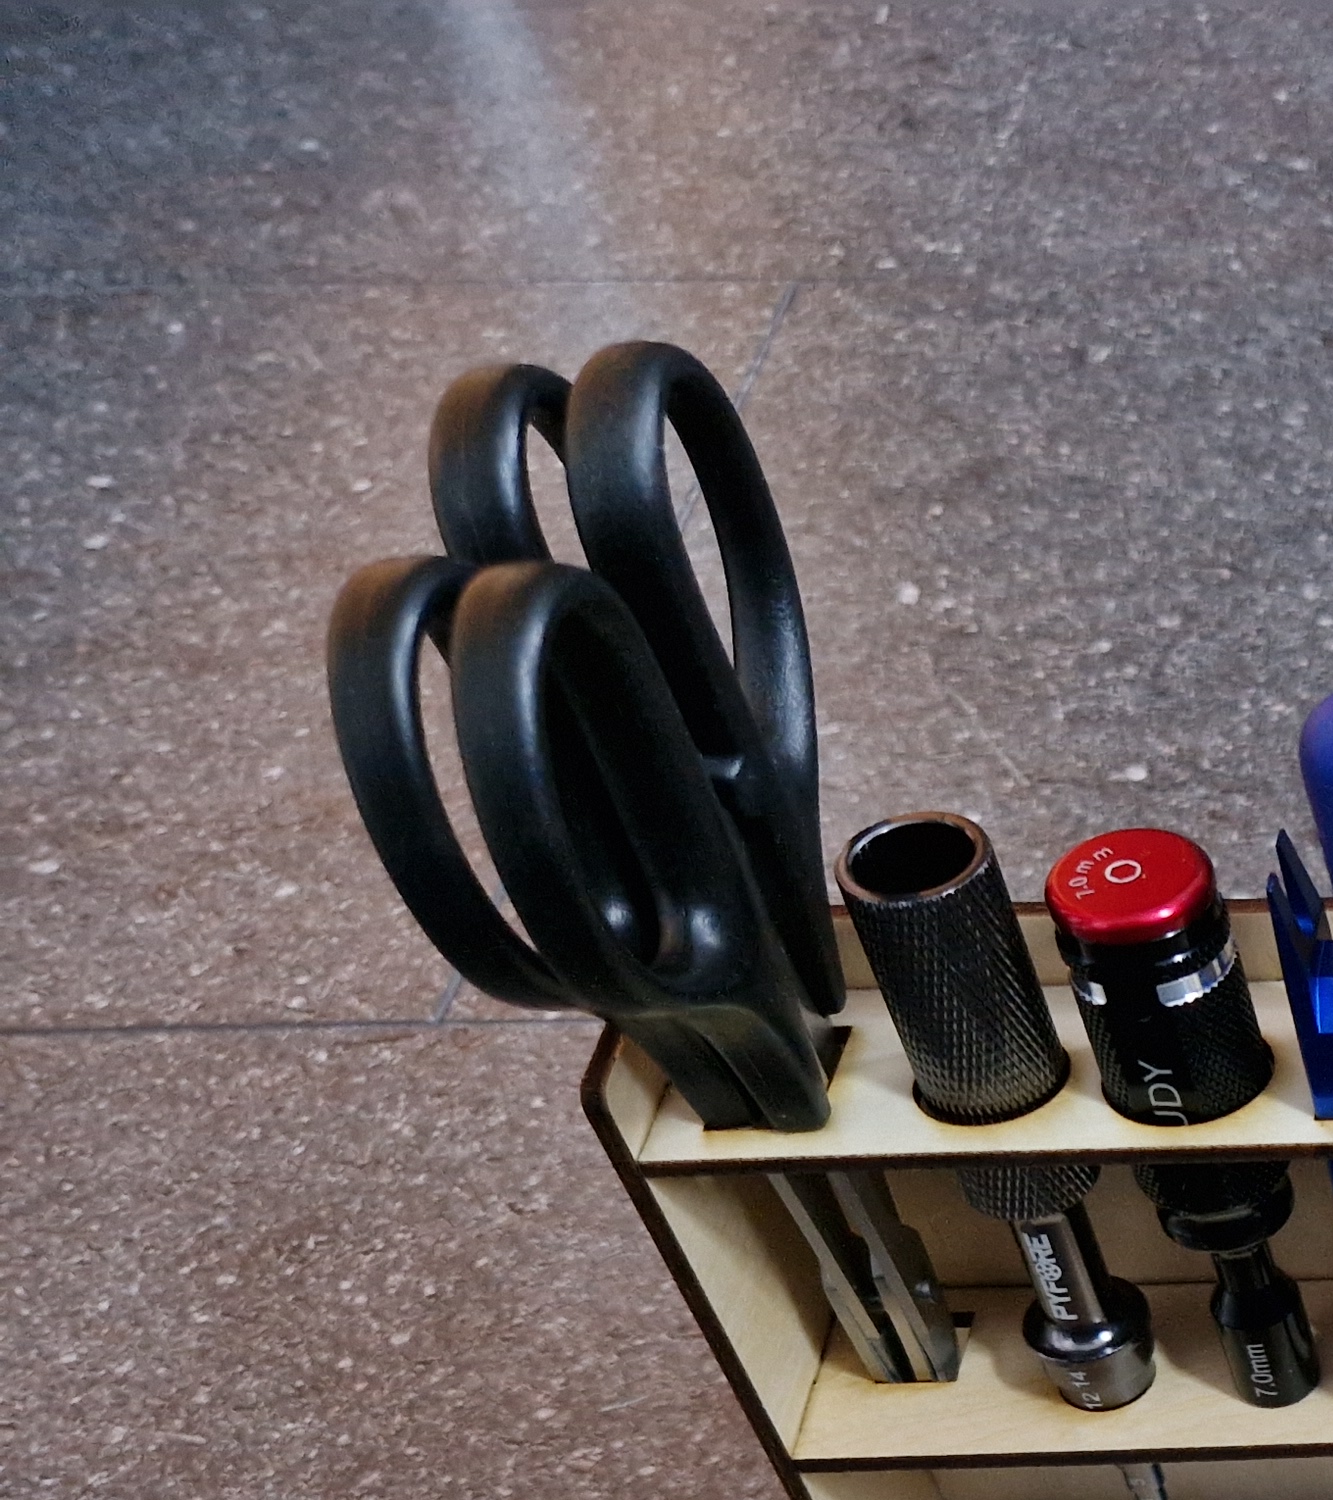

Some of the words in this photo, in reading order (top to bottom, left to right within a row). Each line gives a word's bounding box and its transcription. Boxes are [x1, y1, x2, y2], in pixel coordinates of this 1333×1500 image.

[1245, 1342, 1281, 1398] 7.0mm
[1069, 1371, 1090, 1388] 14
[1082, 1392, 1104, 1410] 12
